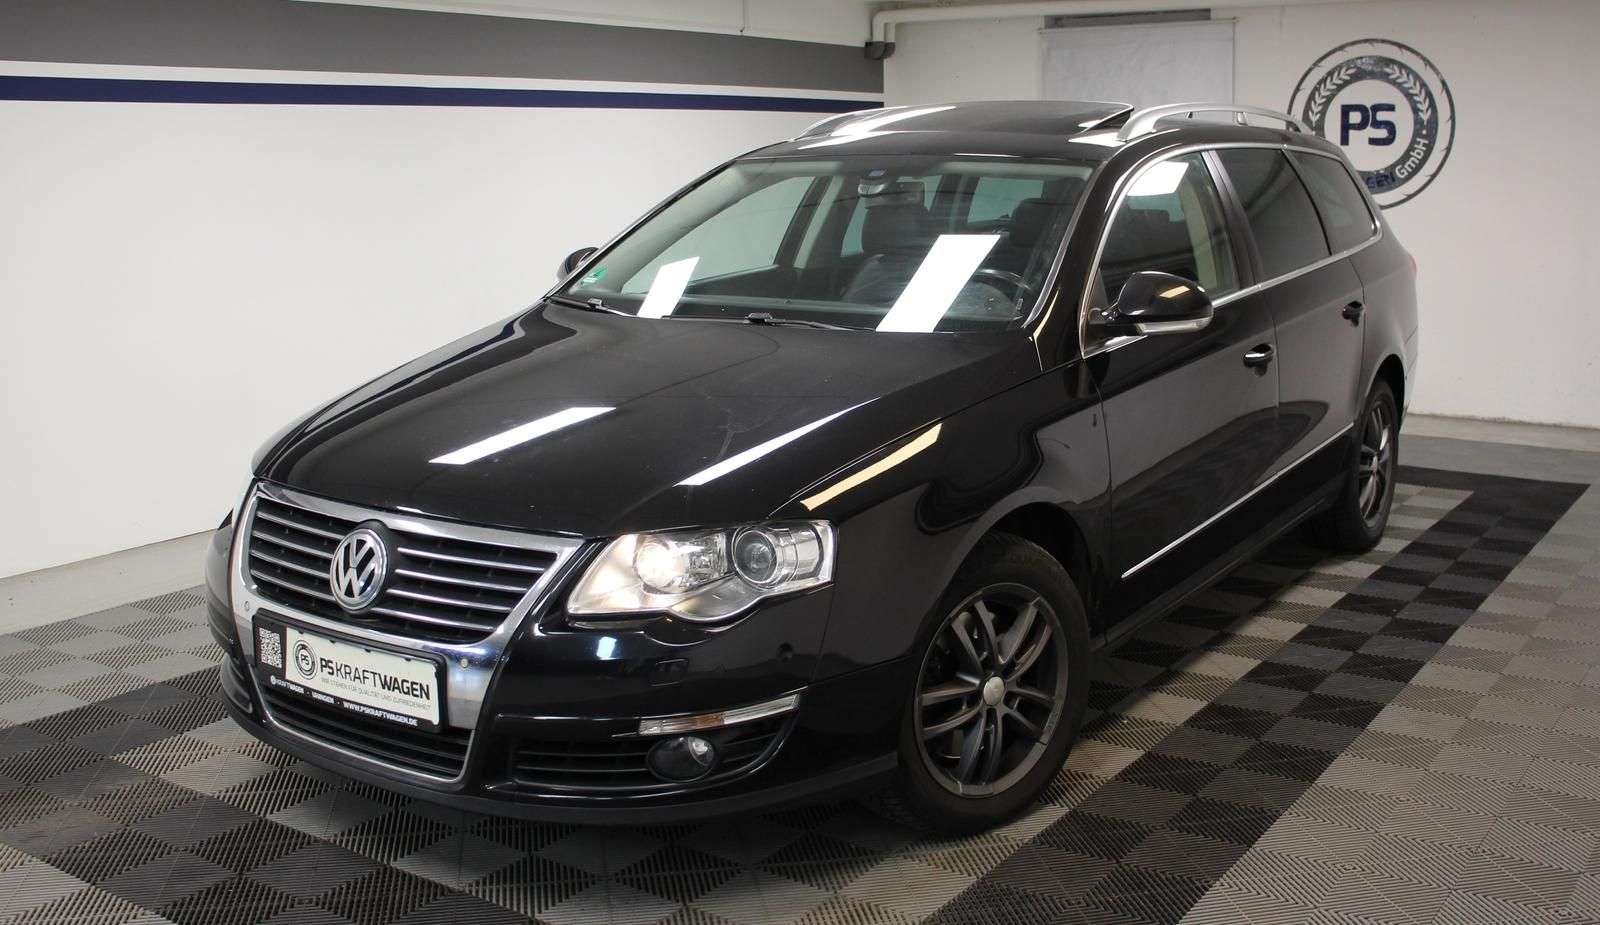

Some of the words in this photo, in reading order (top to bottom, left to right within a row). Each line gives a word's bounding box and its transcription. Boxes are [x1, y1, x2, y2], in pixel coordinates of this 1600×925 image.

[1340, 103, 1397, 146] PS
[1395, 138, 1429, 178] GmbH
[333, 532, 383, 606] VW
